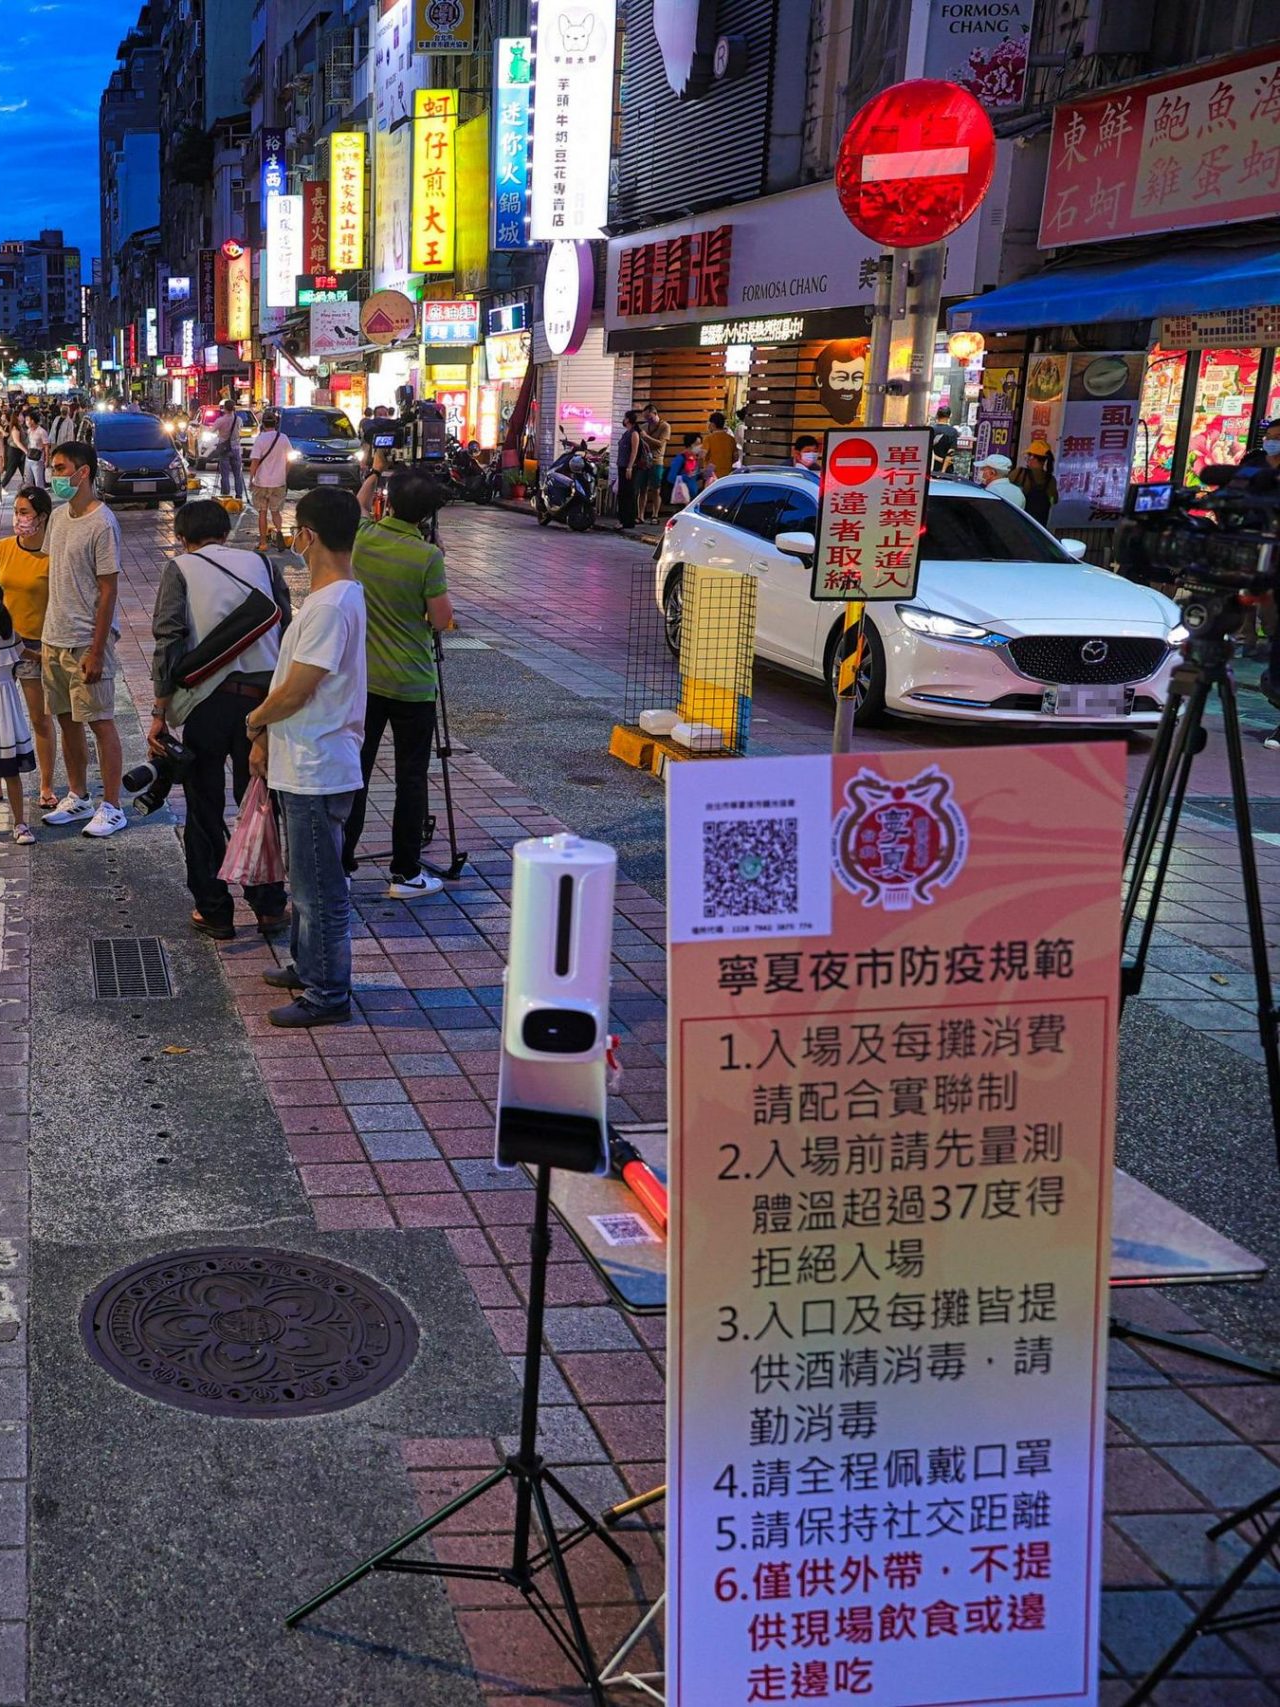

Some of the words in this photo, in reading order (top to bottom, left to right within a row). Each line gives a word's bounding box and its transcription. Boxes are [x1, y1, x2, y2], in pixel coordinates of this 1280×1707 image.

[941, 3, 1020, 18] FORMOSA
[949, 20, 1009, 33] CHANG
[265, 135, 281, 196] 裕生西
[423, 96, 451, 266] 蚵仔煎大王
[499, 102, 522, 244] 迷你火鍋城
[618, 231, 729, 317] 鬍鬚張
[742, 280, 788, 303] FORMOSA
[789, 275, 828, 297] CHANG
[991, 427, 1008, 446] 160
[824, 491, 868, 591] 違者取締
[873, 446, 922, 589] 單行道禁止進入
[869, 808, 917, 881] 寧夏
[718, 938, 1075, 997] 寧夏夜市防疫規範
[719, 1013, 1066, 1071] 1.入場及每攤消費
[752, 1068, 1018, 1127] 請配合實聯制
[718, 1122, 1064, 1181] 2.入場前請先量測
[751, 1175, 1066, 1236] 體溫超過37度得
[751, 1238, 926, 1289] 拒絕入場
[716, 1282, 1058, 1343] 3.入口及每攤皆提
[749, 1400, 878, 1447] 勤消毒
[713, 1438, 1053, 1499] 4.請全程佩戴口罩
[715, 1490, 1052, 1551] 5.請保持社交距離
[747, 1593, 1047, 1652] 供現場飲食或邊
[746, 1656, 874, 1703] 走邊吃
